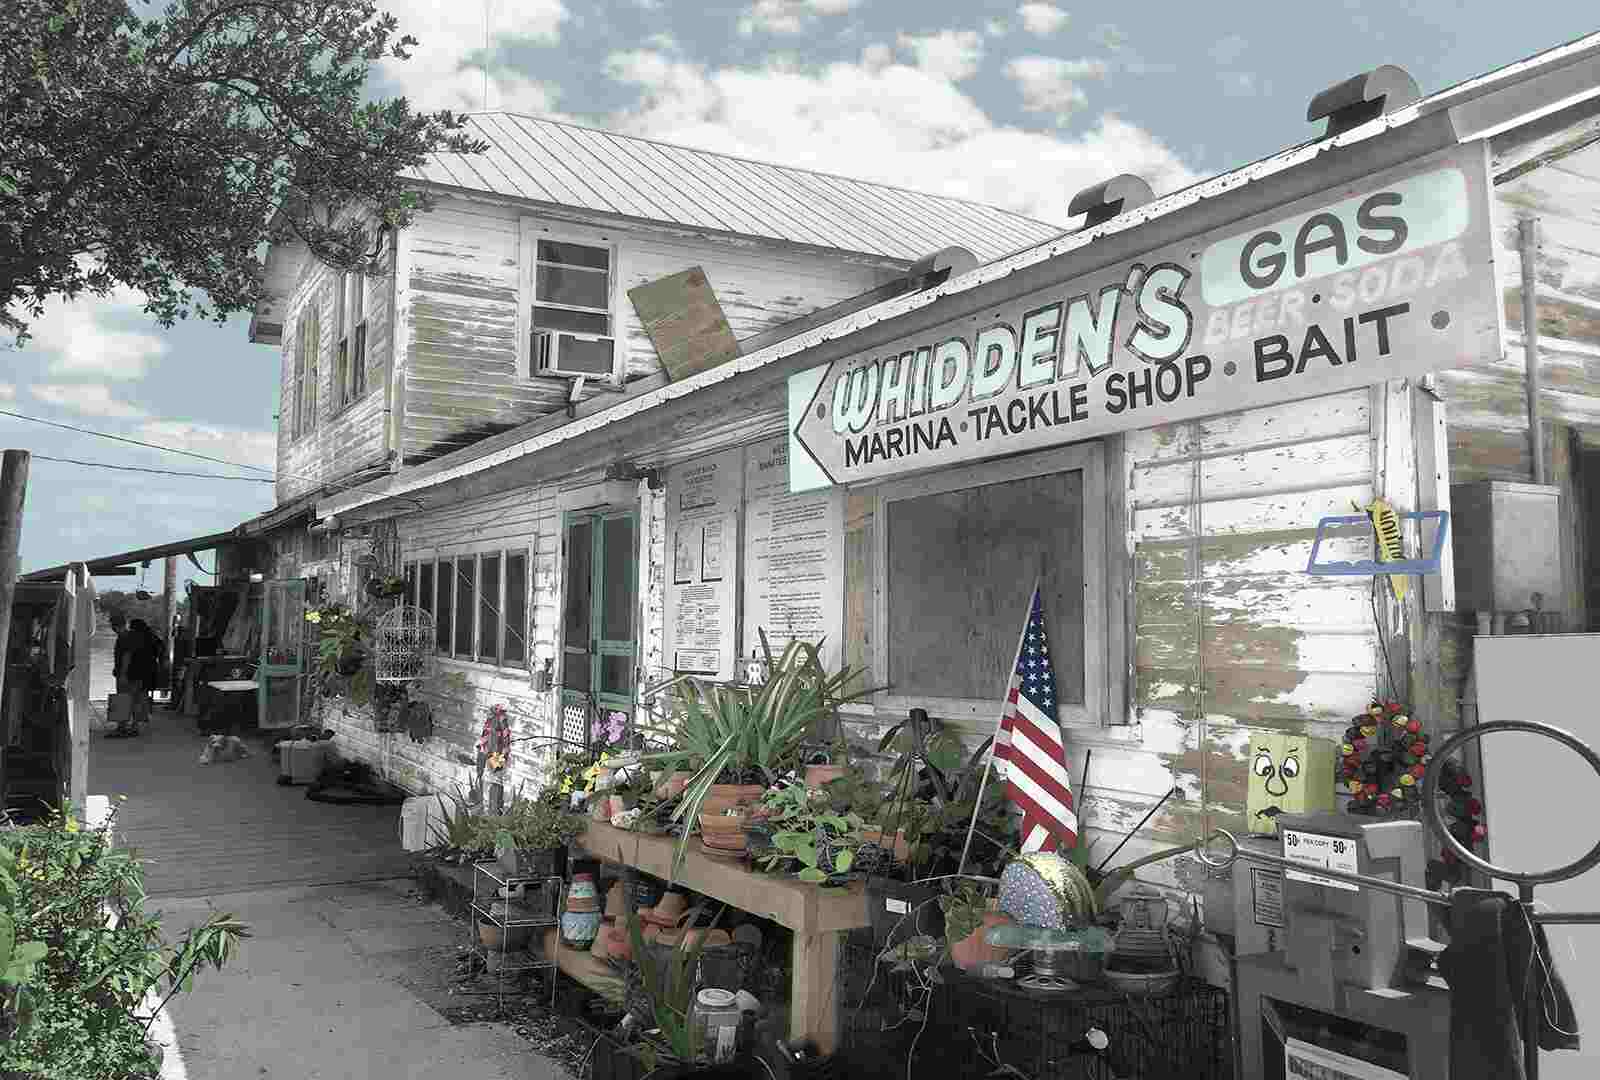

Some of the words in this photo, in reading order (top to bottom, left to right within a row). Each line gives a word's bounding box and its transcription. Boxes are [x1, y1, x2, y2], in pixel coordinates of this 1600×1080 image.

[1204, 289, 1306, 345] BEER
[1330, 241, 1468, 310] SODA
[1240, 192, 1408, 289] GAS
[832, 262, 1191, 434] WHIDDEN'S
[845, 416, 957, 468] MARINA
[968, 384, 1088, 441] TACKLE
[1105, 355, 1211, 415] SHOP
[1254, 302, 1410, 383] BAIT
